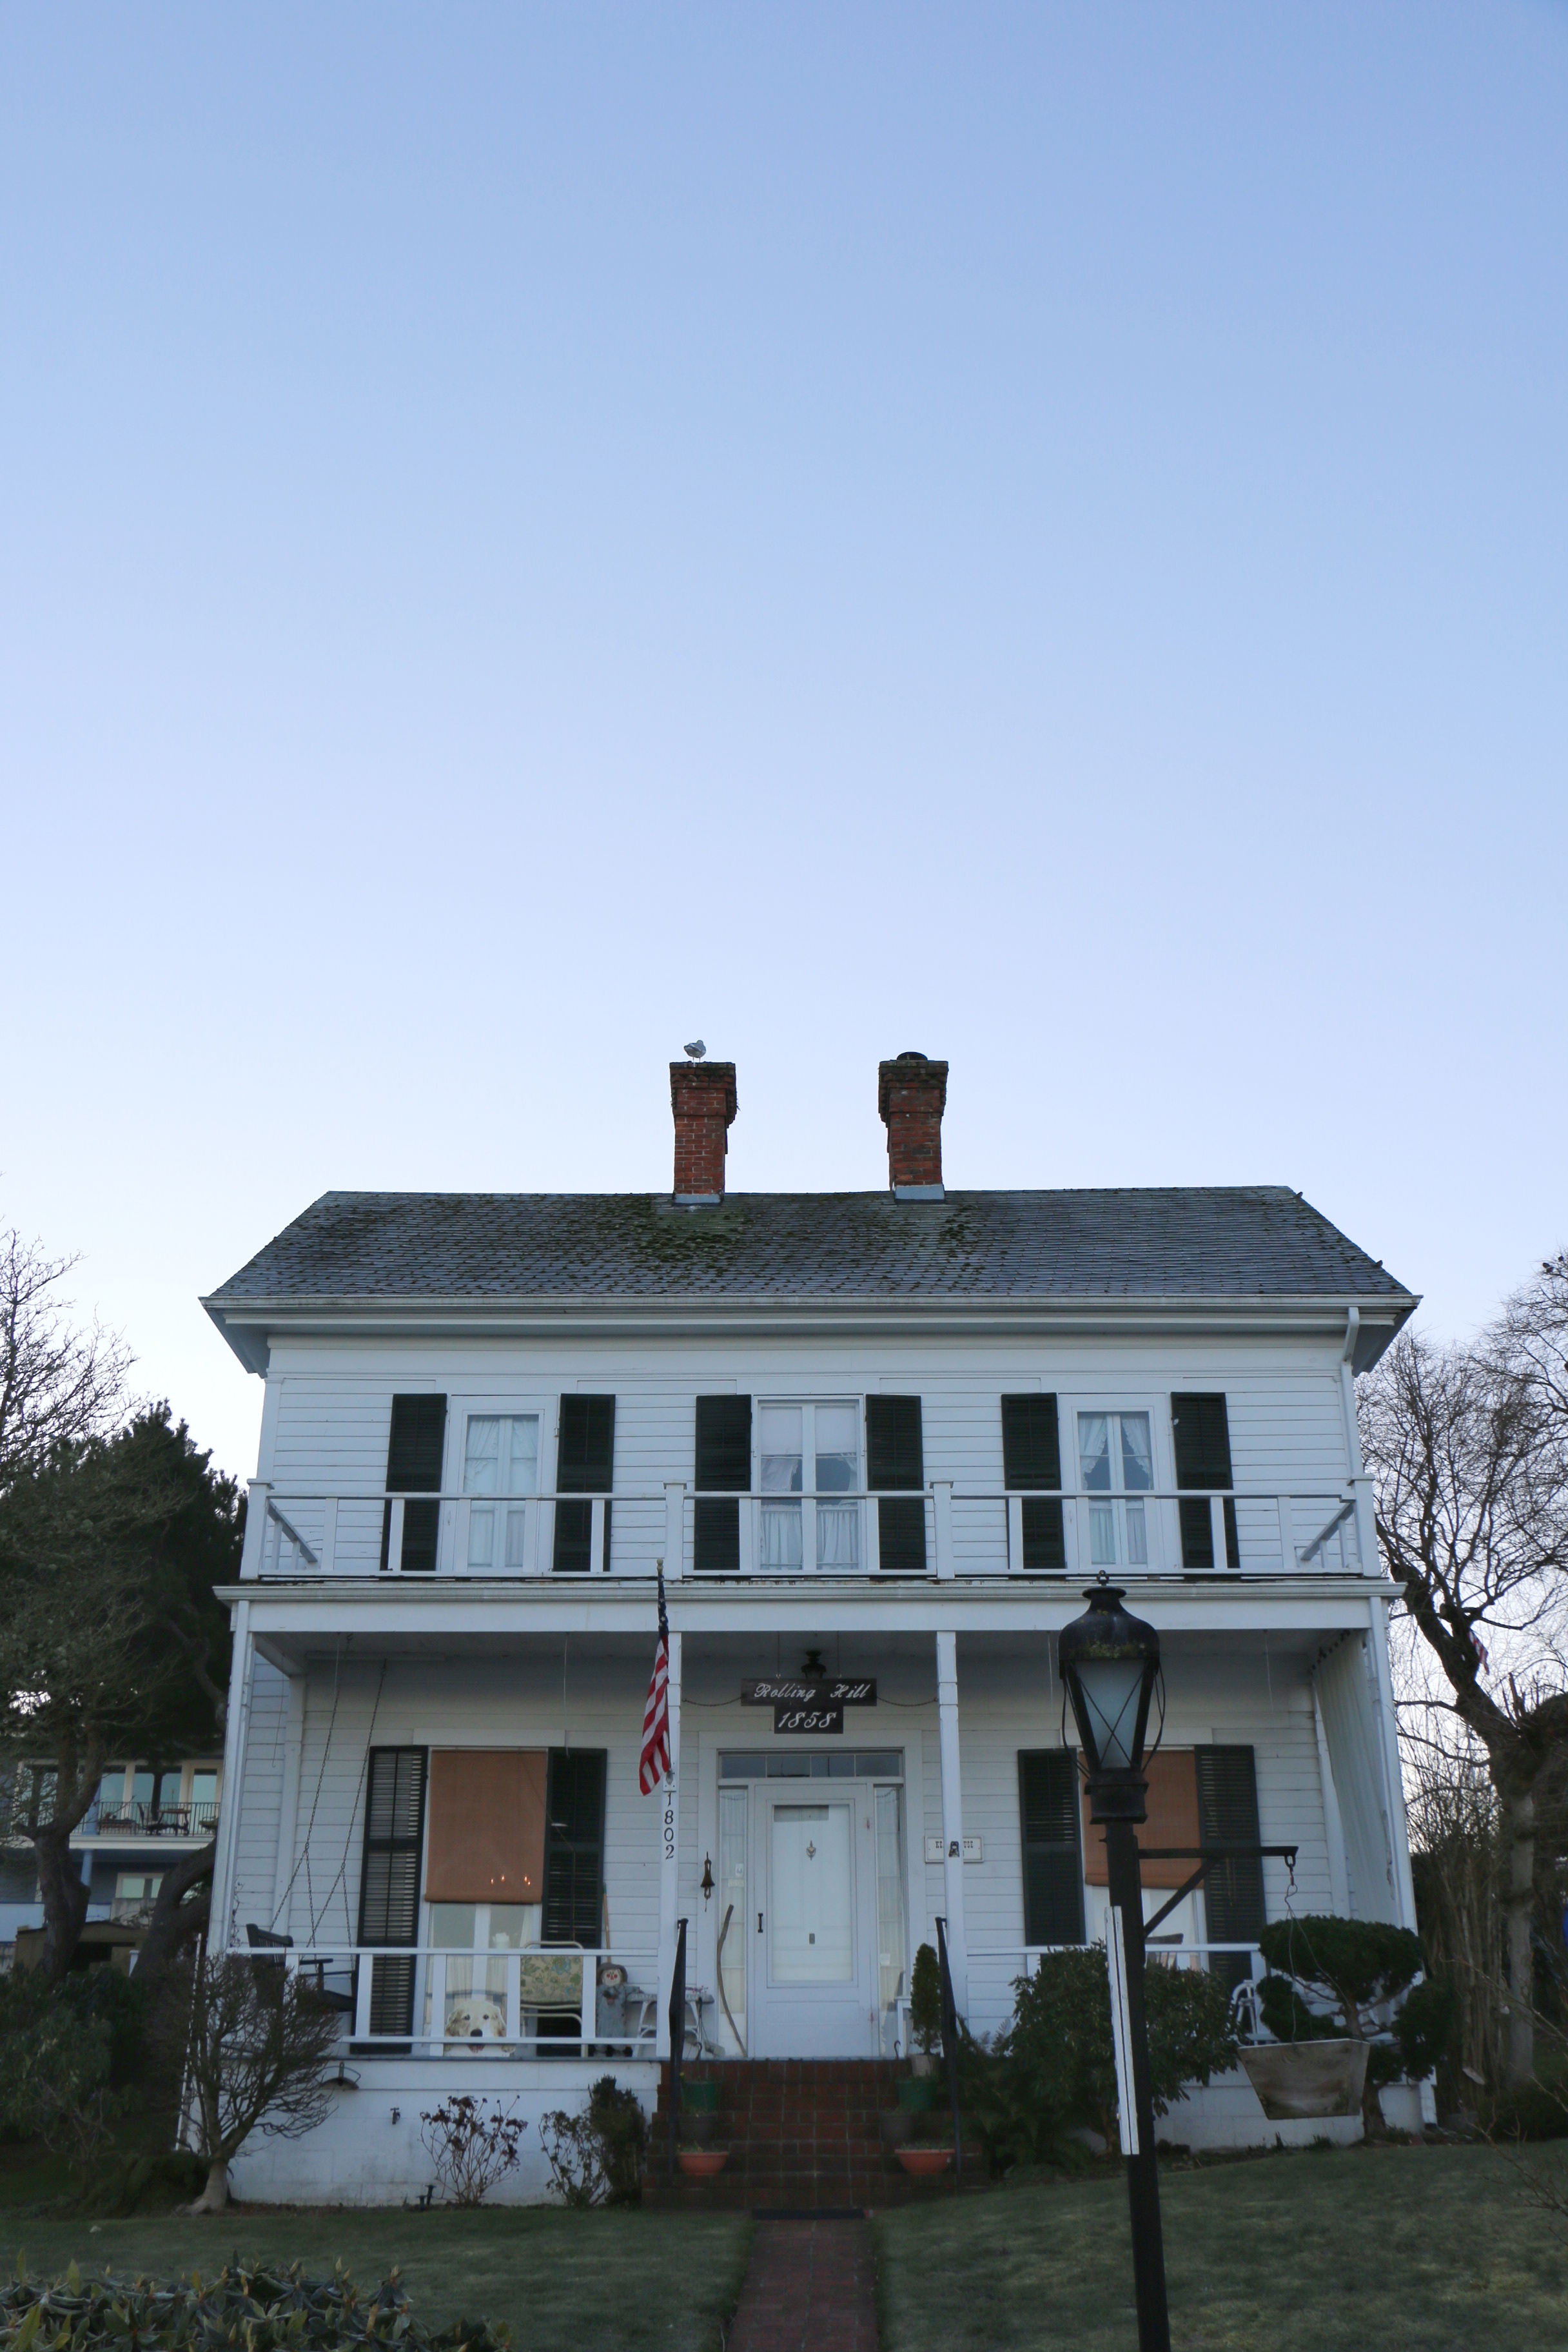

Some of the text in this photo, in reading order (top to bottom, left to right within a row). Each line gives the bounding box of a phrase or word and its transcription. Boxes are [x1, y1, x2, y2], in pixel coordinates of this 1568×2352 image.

[754, 1683, 870, 1701] Rolling Hill
[778, 1712, 837, 1728] 1858
[664, 1792, 674, 1859] 1802
